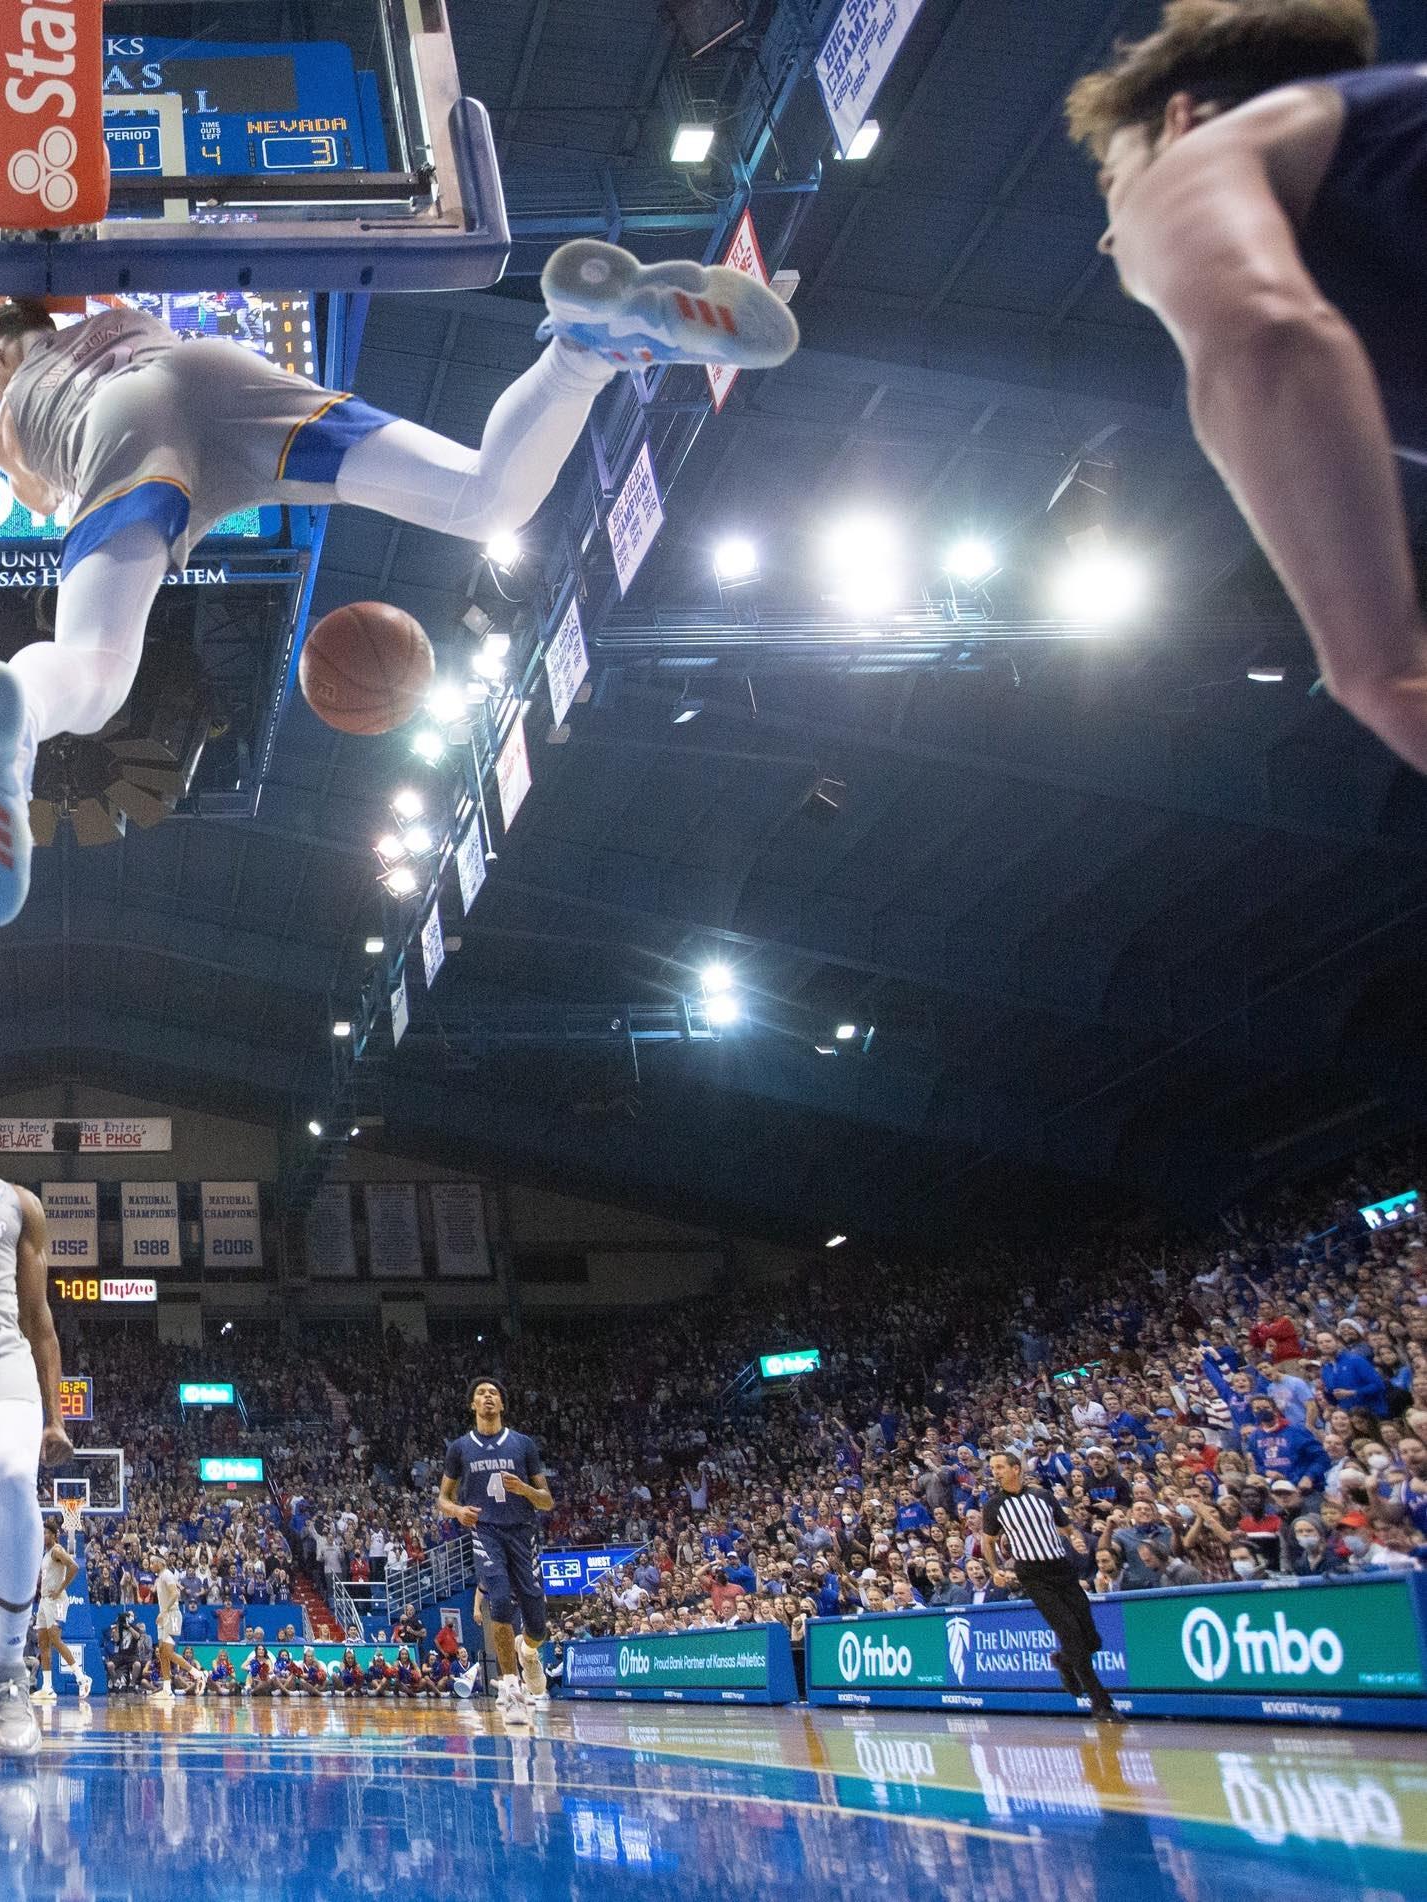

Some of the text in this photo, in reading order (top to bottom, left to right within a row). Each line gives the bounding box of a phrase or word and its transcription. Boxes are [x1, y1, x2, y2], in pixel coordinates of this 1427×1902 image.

[876, 4, 897, 48] 1957
[824, 20, 846, 71] BIG
[5, 0, 76, 118] Sta
[833, 70, 852, 112] 1950
[106, 130, 152, 141] PERIOD
[246, 117, 347, 134] NEVADA
[138, 143, 145, 166] 1
[202, 145, 221, 165] 4
[312, 138, 331, 164] 3
[262, 301, 309, 311] PL F PT
[611, 499, 625, 529] BIG
[613, 471, 650, 549] CHAMPIONS
[48, 1195, 91, 1205] NATIONAL
[128, 1195, 171, 1205] NATIONAL
[209, 1195, 253, 1205] NATIONAL
[124, 1209, 176, 1218] CHAMPIONS
[204, 1209, 258, 1218] CHAMPIONS
[51, 1239, 88, 1255] 1952
[133, 1239, 170, 1255] 1988
[212, 1239, 253, 1255] 2008
[55, 1279, 99, 1300] 7:08
[103, 1282, 153, 1299] HyVee
[470, 1458, 515, 1473] NEVADA
[486, 1472, 506, 1502] 4
[587, 1556, 610, 1567] GUEST
[974, 1629, 1057, 1650] THE UNIVERSI
[1232, 1611, 1343, 1675] fnbo
[630, 1649, 766, 1674] fnbo Proud Bank Partner of Kansas Athletics
[863, 1634, 912, 1677] fnbo
[976, 1651, 1055, 1672] KANSAS HEAL
[1262, 1701, 1342, 1719] ROCKET Mortgage
